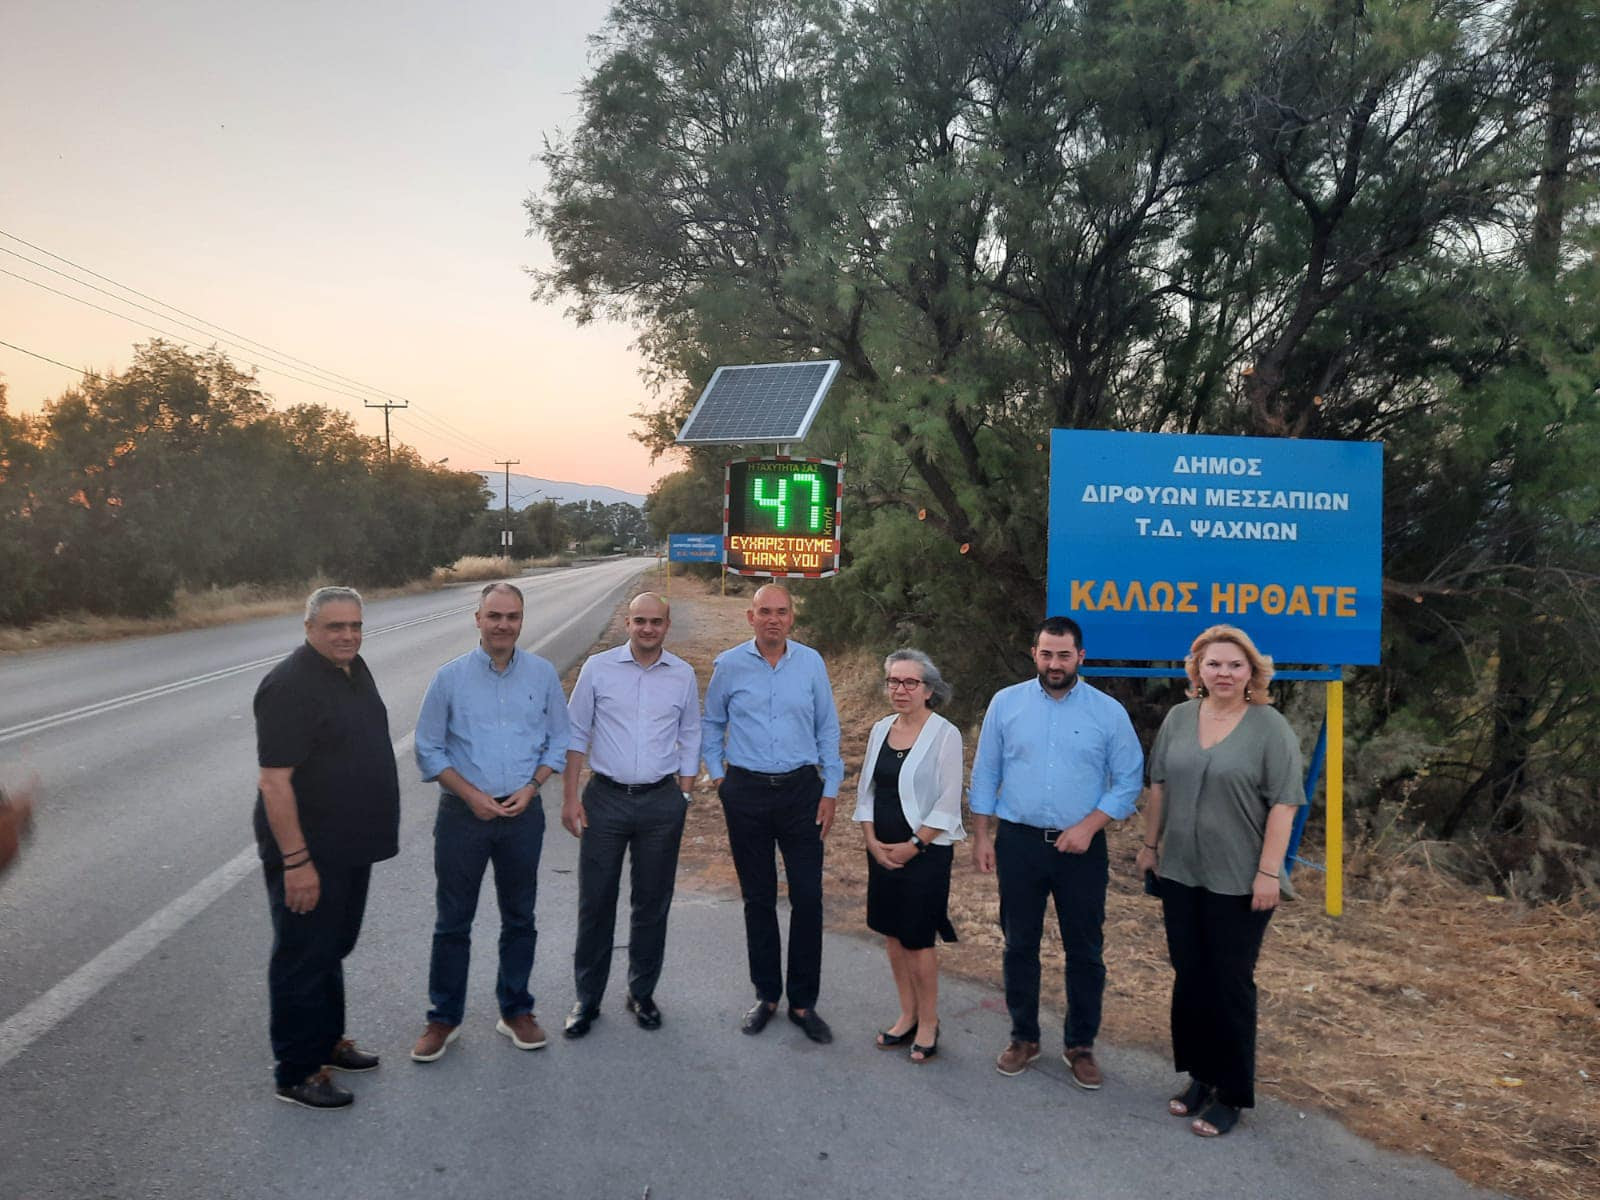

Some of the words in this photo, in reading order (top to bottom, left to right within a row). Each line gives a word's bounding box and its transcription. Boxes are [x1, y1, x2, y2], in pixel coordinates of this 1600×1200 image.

[755, 464, 800, 472] ΤΑΧΥΤΗΤΑ
[802, 464, 818, 472] ΣΑΣ
[1173, 456, 1262, 476] ΔΗΜΟΣ
[754, 474, 820, 528] 47
[1082, 485, 1196, 505] ΔΙΡΦΥΩΝ
[1205, 489, 1350, 510] ΜΕΣΣΑΠΙΩΝ
[1136, 518, 1182, 537] Τ.Δ.
[1190, 521, 1297, 540] ΨΑΧΝΩΝ
[731, 536, 832, 552] ΕΥΧΑΡΙΣΤΟΥΜΕ
[743, 552, 786, 566] THANK
[793, 554, 818, 567] YOU
[1070, 580, 1198, 612] ΚΑΛΩΣ
[1211, 583, 1357, 616] ΗΡΘΑΤΕ
